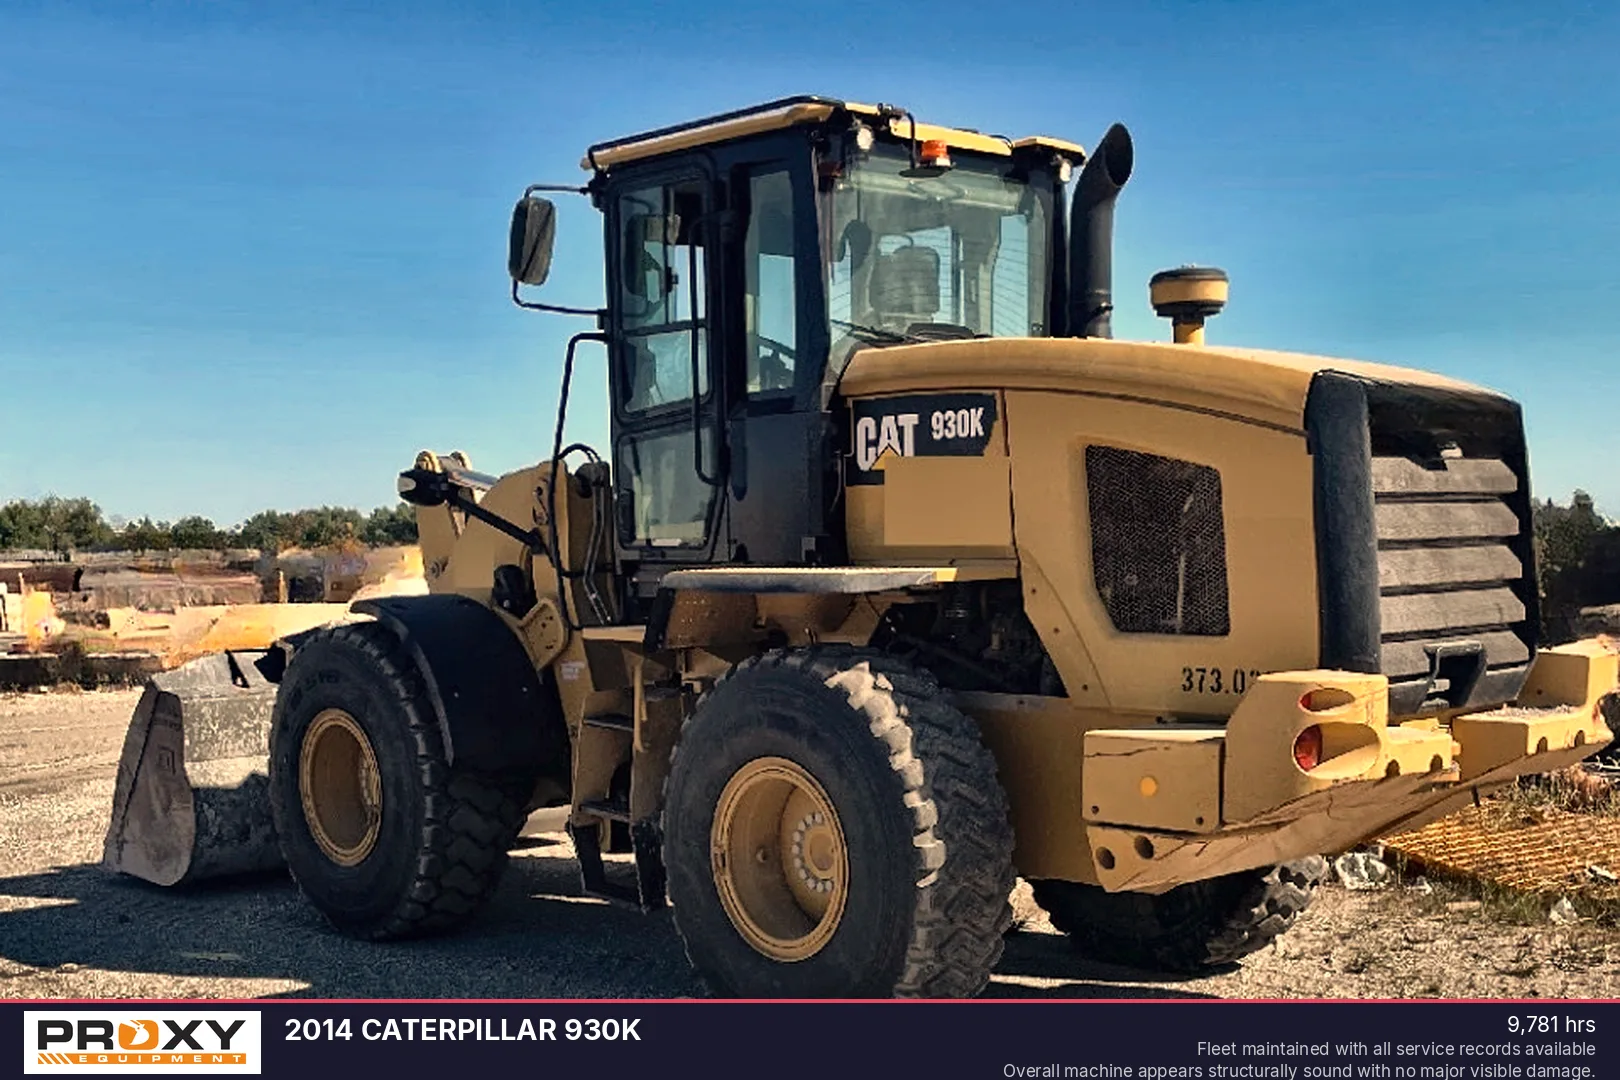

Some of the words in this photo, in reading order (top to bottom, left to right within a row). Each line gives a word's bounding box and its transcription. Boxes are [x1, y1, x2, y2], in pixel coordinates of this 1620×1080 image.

[857, 413, 919, 471] CAT
[931, 407, 985, 440] 930K
[1182, 666, 1260, 694] 373.0
